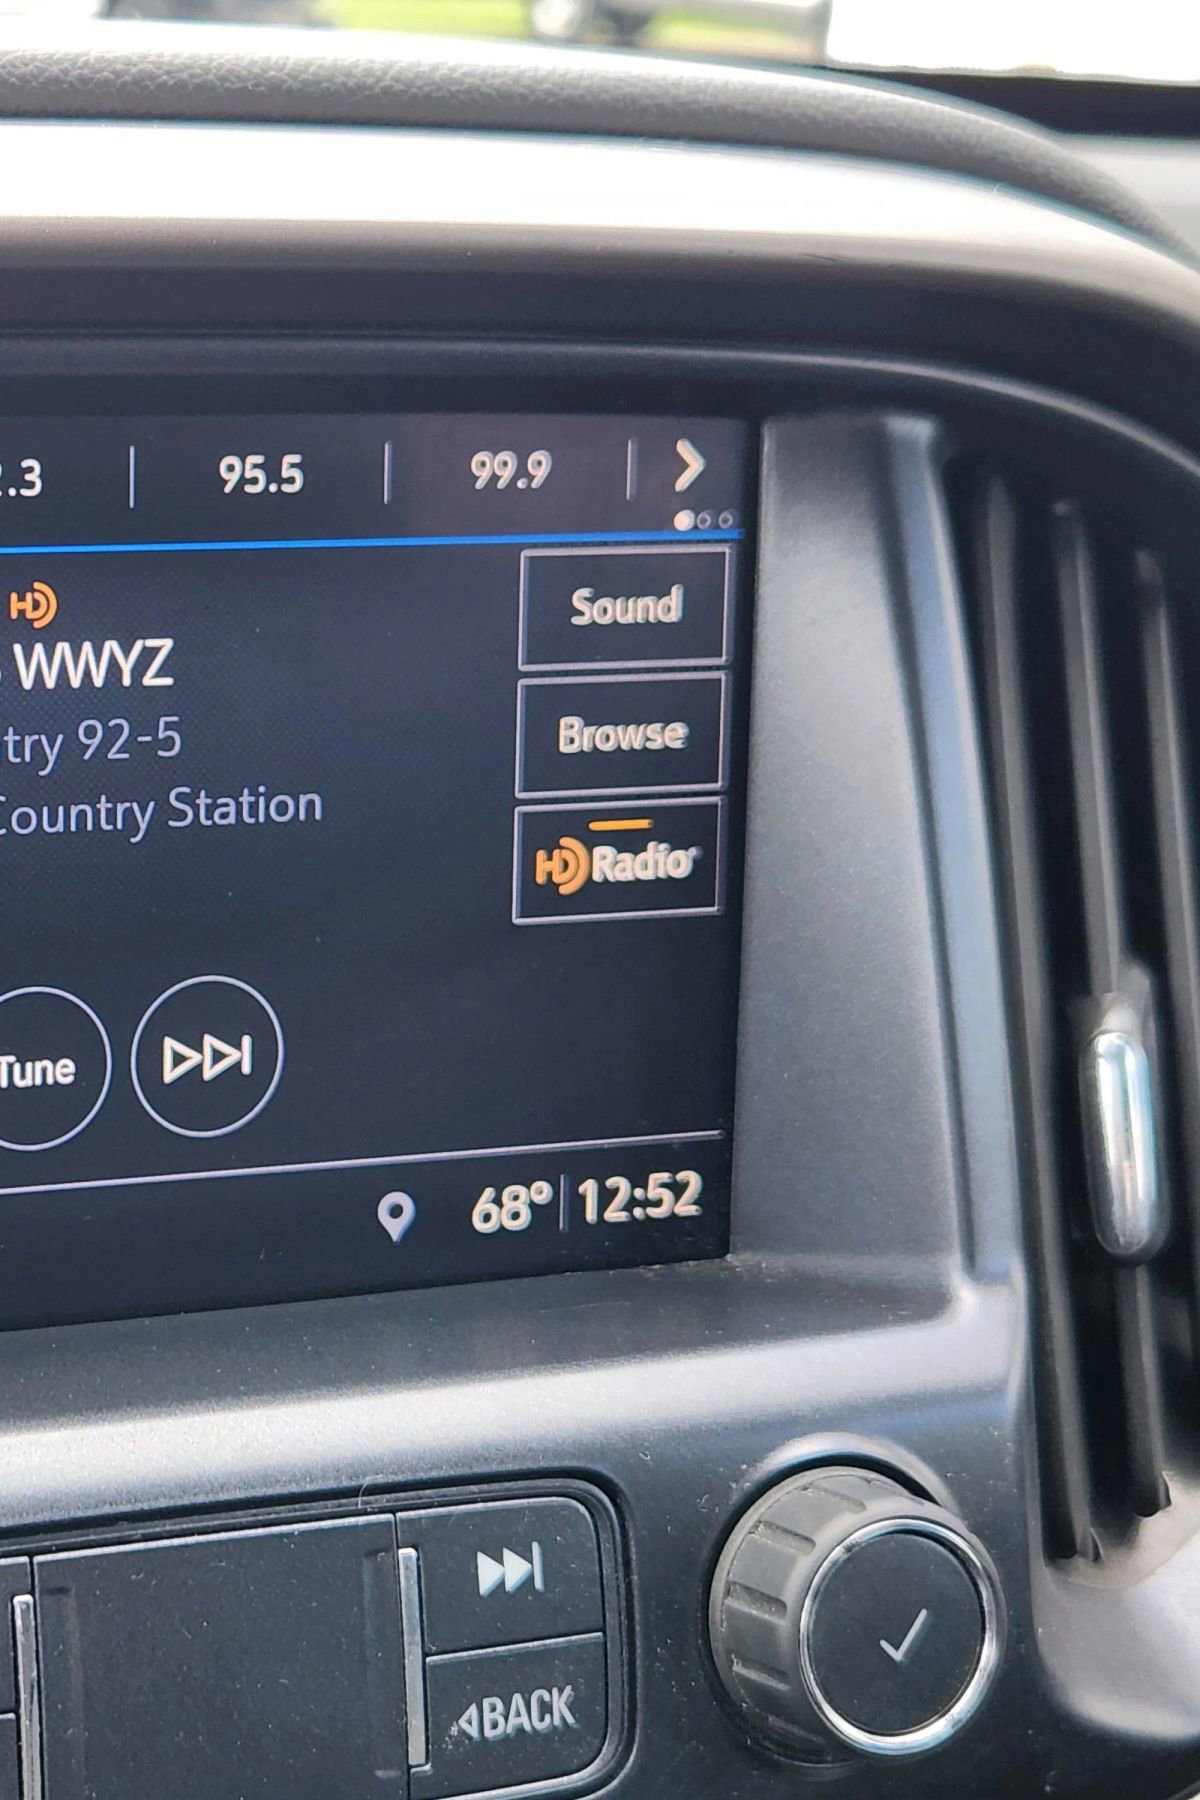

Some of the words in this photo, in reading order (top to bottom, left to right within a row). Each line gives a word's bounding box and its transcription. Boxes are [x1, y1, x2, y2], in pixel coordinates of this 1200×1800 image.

[218, 453, 305, 495] 95.5
[470, 449, 553, 491] 99.9
[9, 584, 56, 627] HD
[570, 583, 684, 627] Sound
[12, 637, 175, 690] WWYZ
[78, 715, 182, 763] 92-5
[558, 715, 690, 754] Browse
[167, 784, 324, 831] Station
[535, 841, 588, 892] HD
[577, 1169, 704, 1224] 12:52
[480, 1684, 577, 1738] BACK
